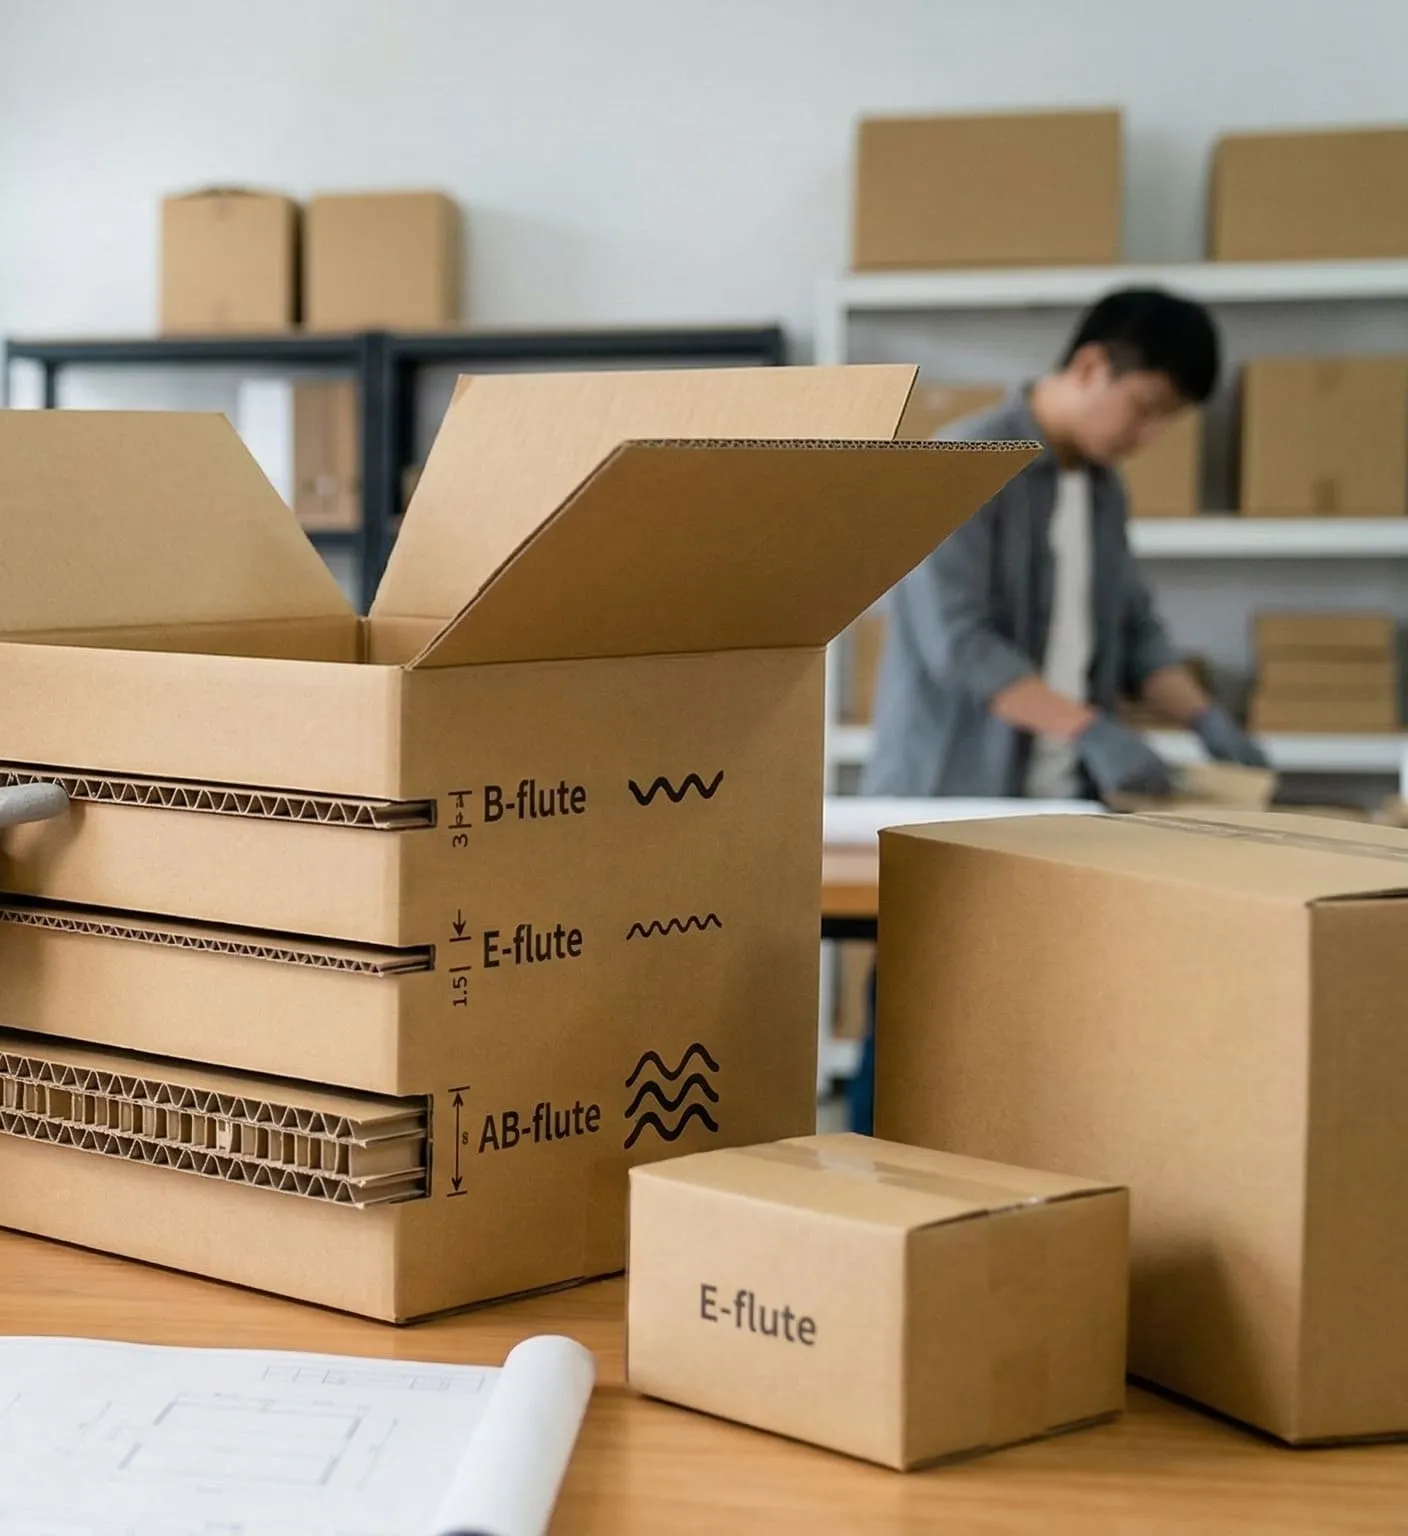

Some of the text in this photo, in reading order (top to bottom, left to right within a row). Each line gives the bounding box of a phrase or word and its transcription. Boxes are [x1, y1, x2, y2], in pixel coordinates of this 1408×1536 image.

[483, 779, 587, 822] B-flute
[452, 833, 468, 848] 3
[483, 922, 583, 968] E-flute
[452, 976, 468, 1007] 1.5
[478, 1101, 602, 1153] AB-flute
[700, 1283, 817, 1347] E-flute
